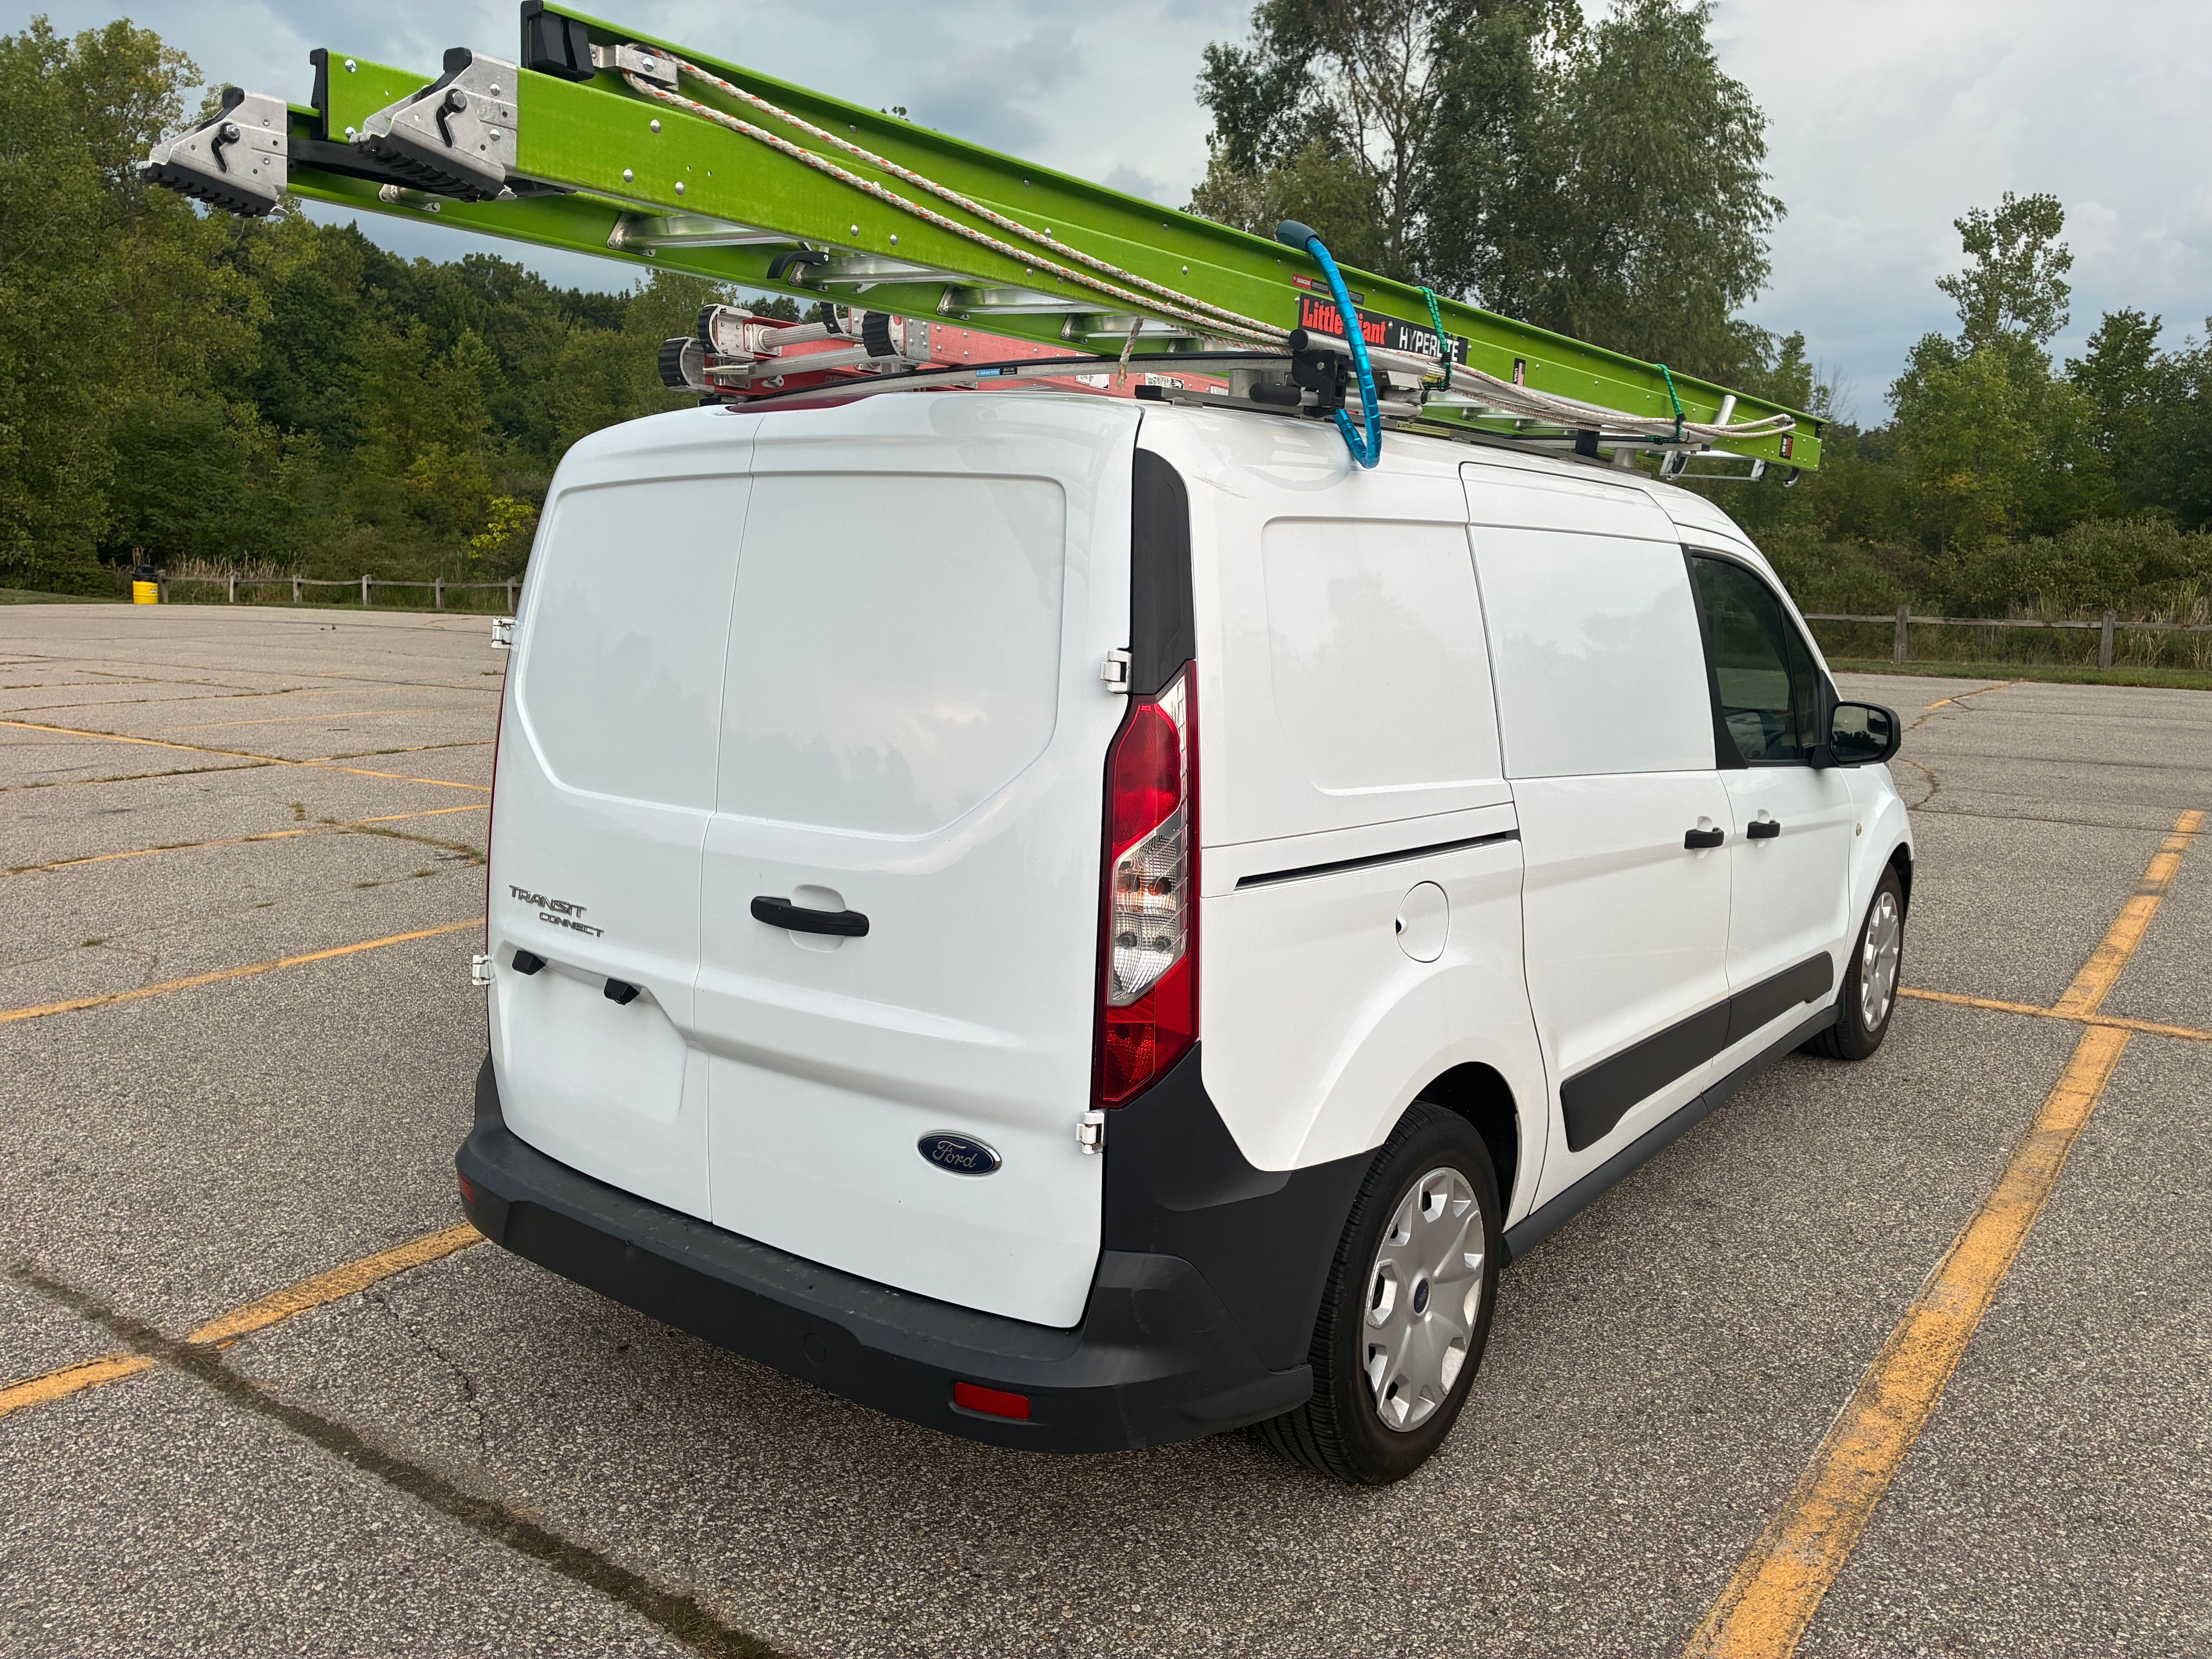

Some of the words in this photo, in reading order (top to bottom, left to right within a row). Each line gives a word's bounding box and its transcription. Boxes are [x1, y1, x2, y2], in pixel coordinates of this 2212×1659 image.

[1302, 299, 1343, 335] Little
[1356, 313, 1386, 345] iant
[1399, 326, 1460, 362] HYPERLTE
[508, 884, 587, 918] TRANSIT
[539, 912, 605, 937] CONNECT
[932, 1140, 978, 1168] Ford
